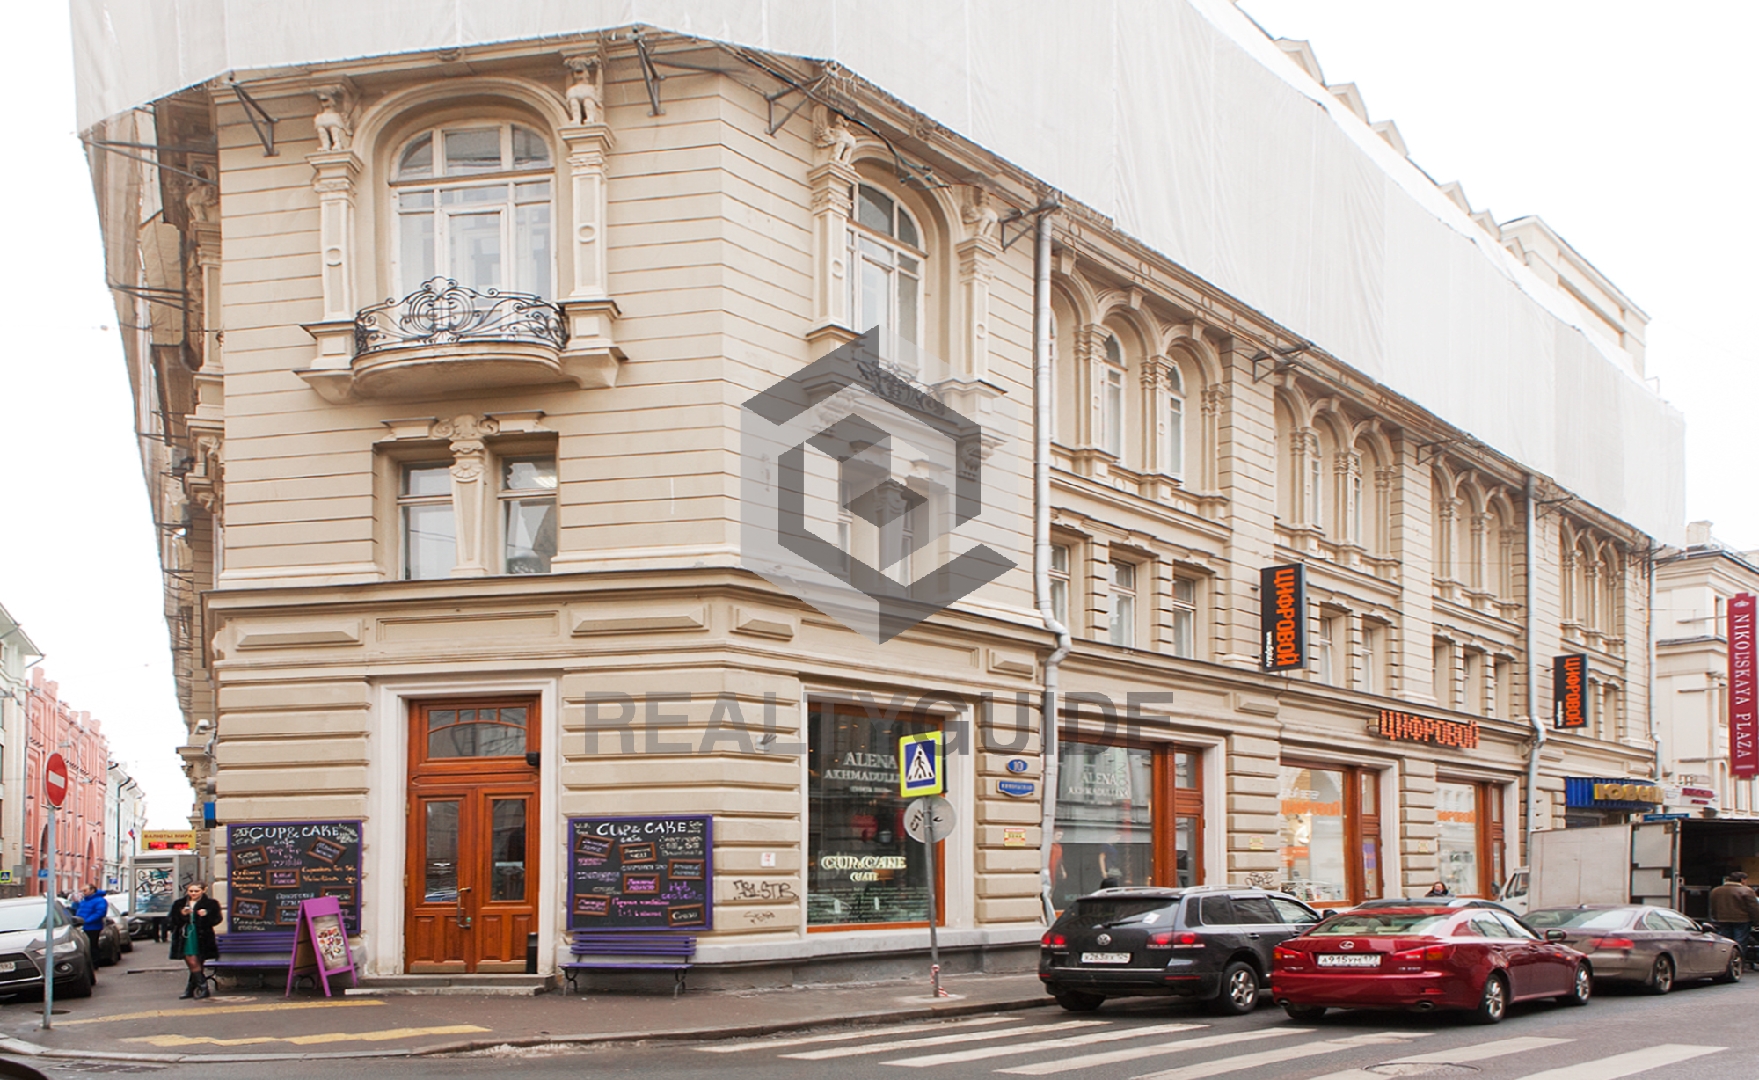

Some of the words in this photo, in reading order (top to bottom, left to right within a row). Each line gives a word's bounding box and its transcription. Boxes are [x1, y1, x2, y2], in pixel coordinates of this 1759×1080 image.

[1274, 568, 1300, 666] ЦИФРОВОЙ
[1563, 657, 1584, 727] ЦИФРОВОЙ
[1381, 710, 1479, 749] ЦИФРОВОЙ
[1735, 712, 1753, 758] PLAZA
[842, 751, 898, 769] ALENA
[1013, 761, 1024, 771] 10
[302, 825, 340, 838] CAKE
[644, 820, 687, 835] CAKE
